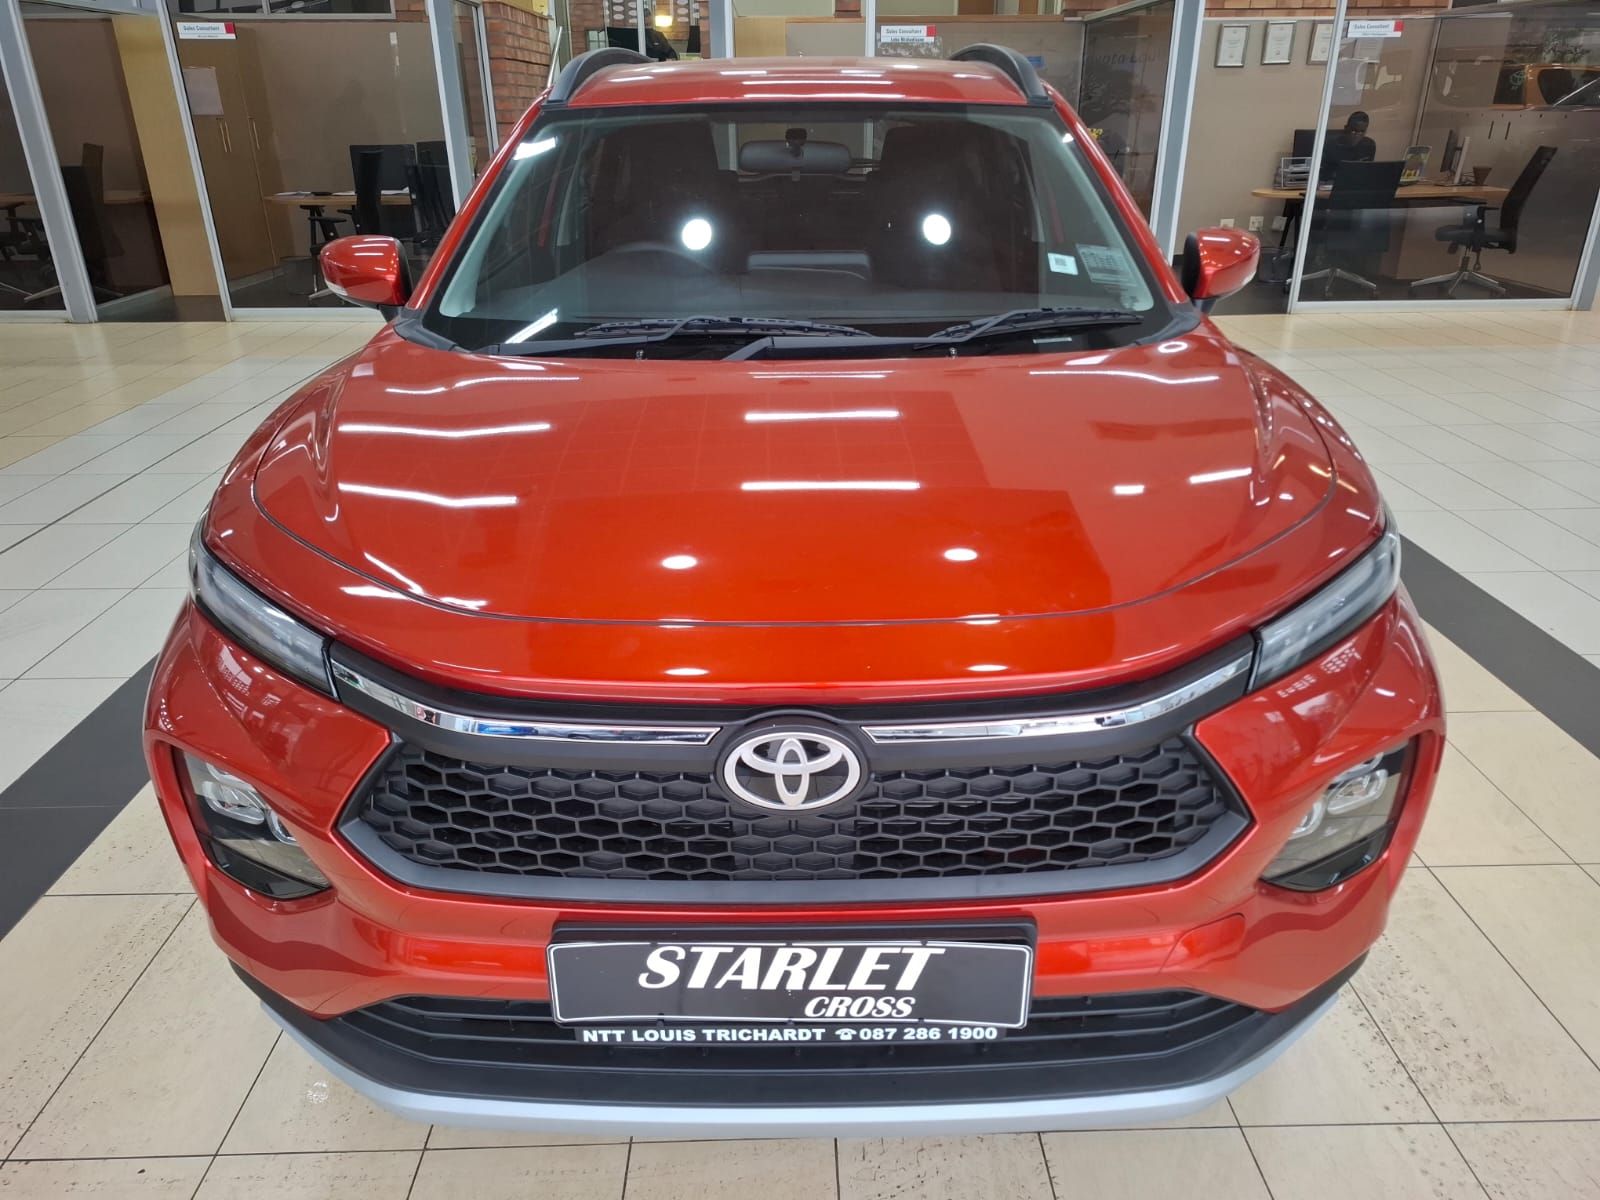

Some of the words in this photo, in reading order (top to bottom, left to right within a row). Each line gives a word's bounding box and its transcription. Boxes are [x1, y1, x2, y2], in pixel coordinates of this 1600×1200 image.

[637, 945, 946, 992] STARLET
[804, 995, 916, 1018] CROSS
[583, 1029, 625, 1042] NTT
[631, 1029, 696, 1042] LOUIS
[702, 1028, 826, 1042] TRICHARDT
[859, 1027, 898, 1040] 087
[903, 1027, 942, 1040] 286
[947, 1026, 998, 1040] 1900
